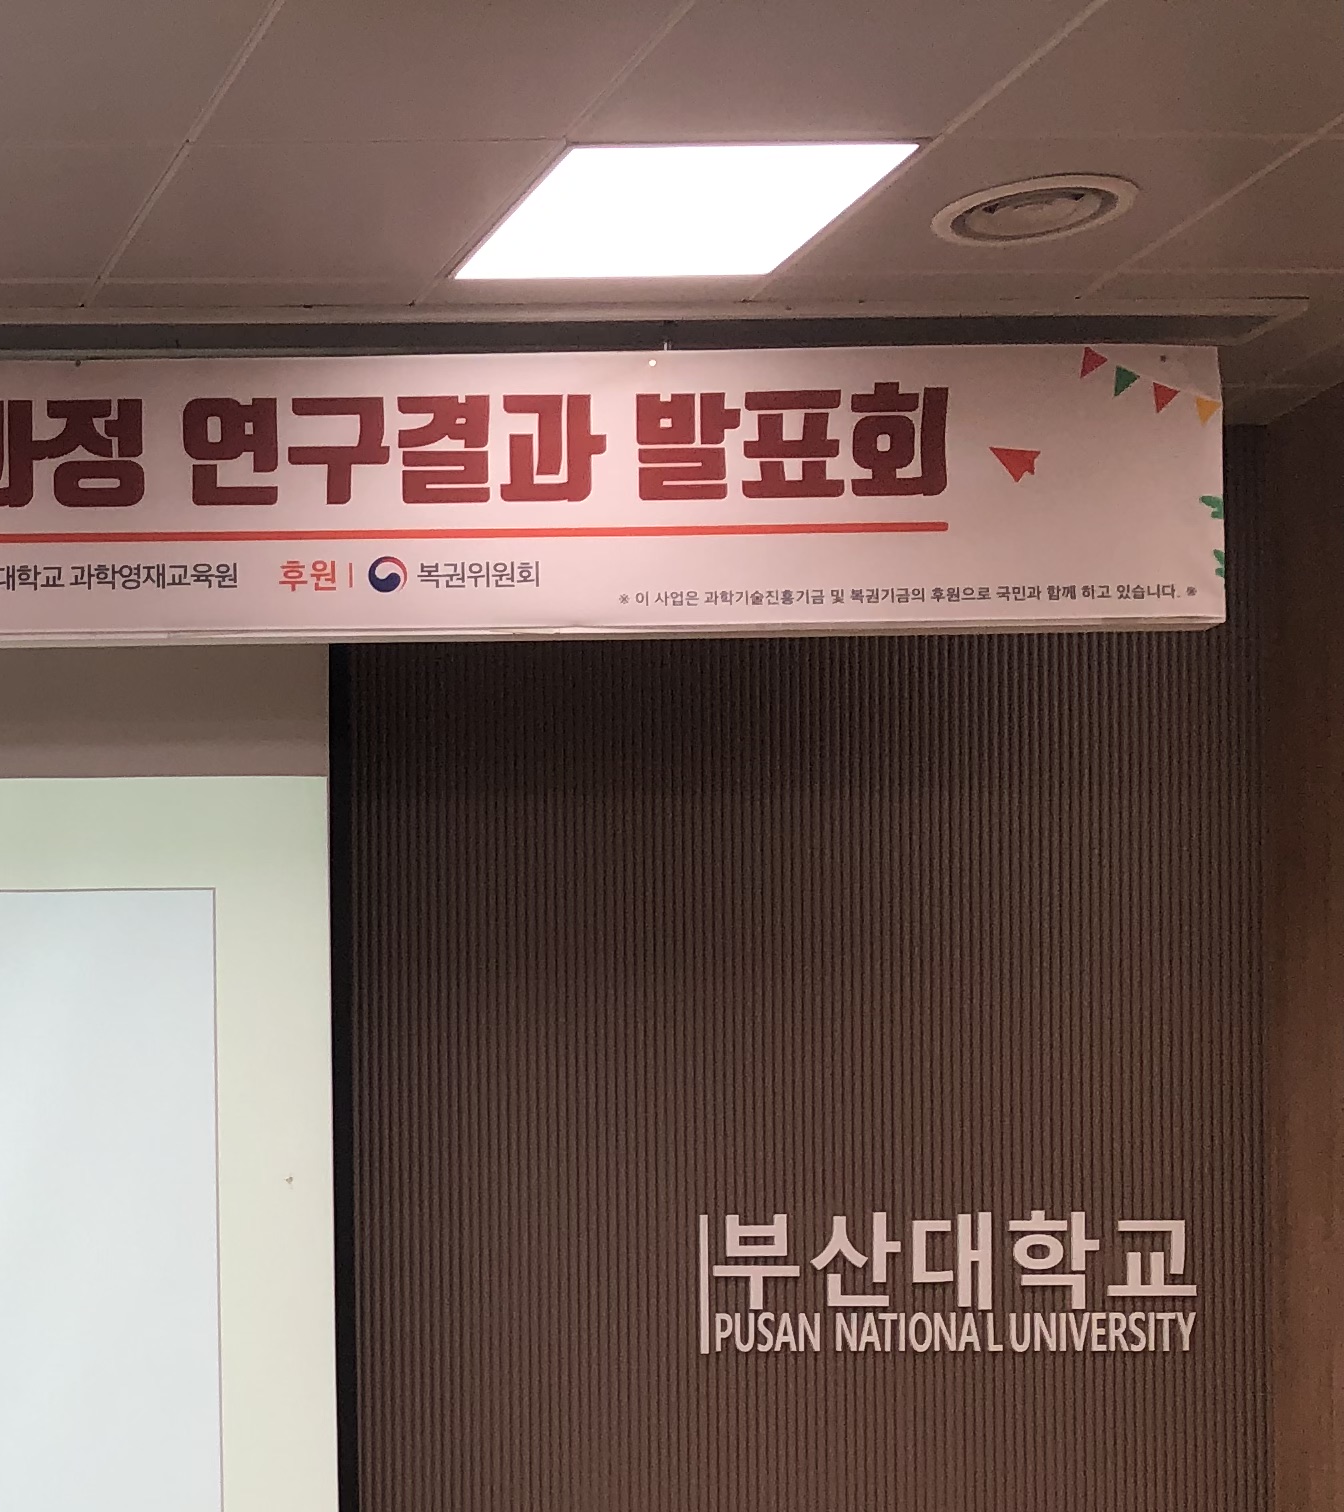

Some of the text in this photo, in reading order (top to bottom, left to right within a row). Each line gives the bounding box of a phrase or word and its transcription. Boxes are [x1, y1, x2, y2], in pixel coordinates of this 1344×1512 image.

[182, 395, 605, 508] 연구결과
[635, 381, 950, 502] 발표회
[69, 561, 240, 592] 과학영재교육원
[278, 559, 337, 593] 후원
[417, 560, 541, 591] 복권위원회
[635, 591, 649, 606] 이
[654, 590, 700, 607] 사업은
[830, 588, 845, 605] 및
[850, 587, 925, 605] 복권기금의
[930, 586, 992, 603] 후원으로
[996, 585, 1042, 602] 국민과
[1047, 585, 1077, 601] 함께
[712, 1209, 1198, 1311] 부산대학교
[714, 1310, 1197, 1353] PUSAN NATIONAL UNIVERSITY
